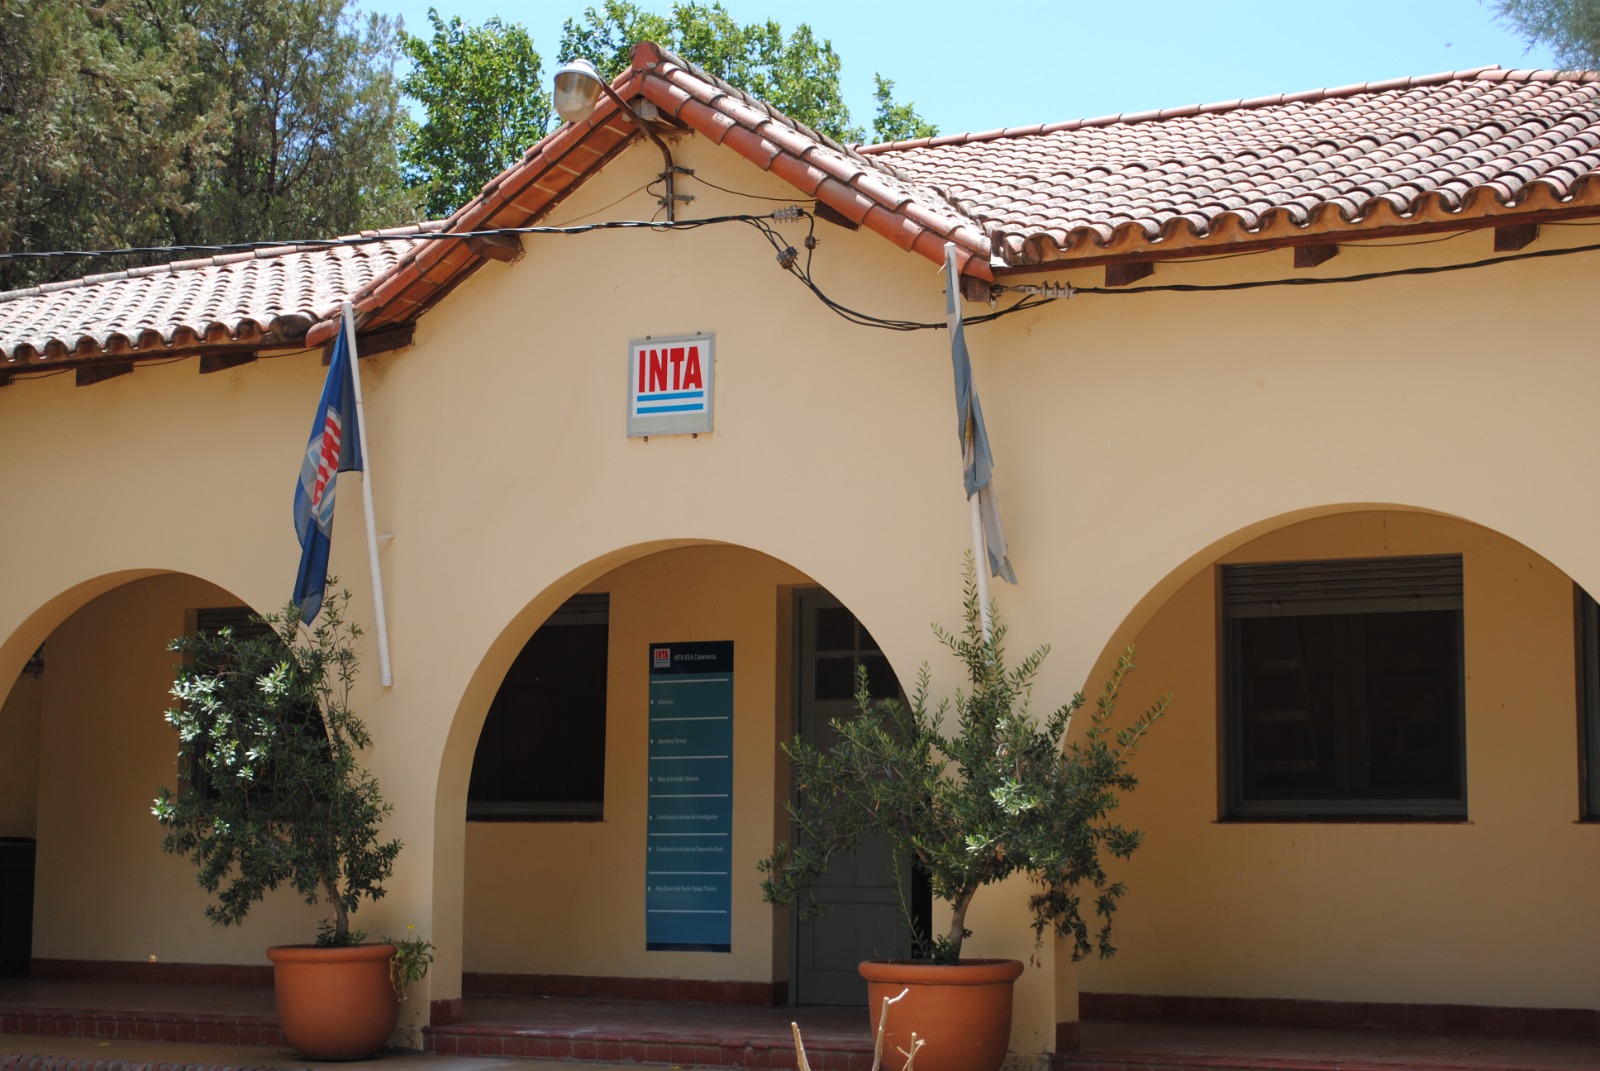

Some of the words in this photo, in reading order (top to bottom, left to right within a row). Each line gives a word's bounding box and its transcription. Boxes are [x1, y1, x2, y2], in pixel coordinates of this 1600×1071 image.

[638, 346, 703, 393] INTA
[655, 649, 669, 659] INTA
[684, 653, 694, 661] EEA
